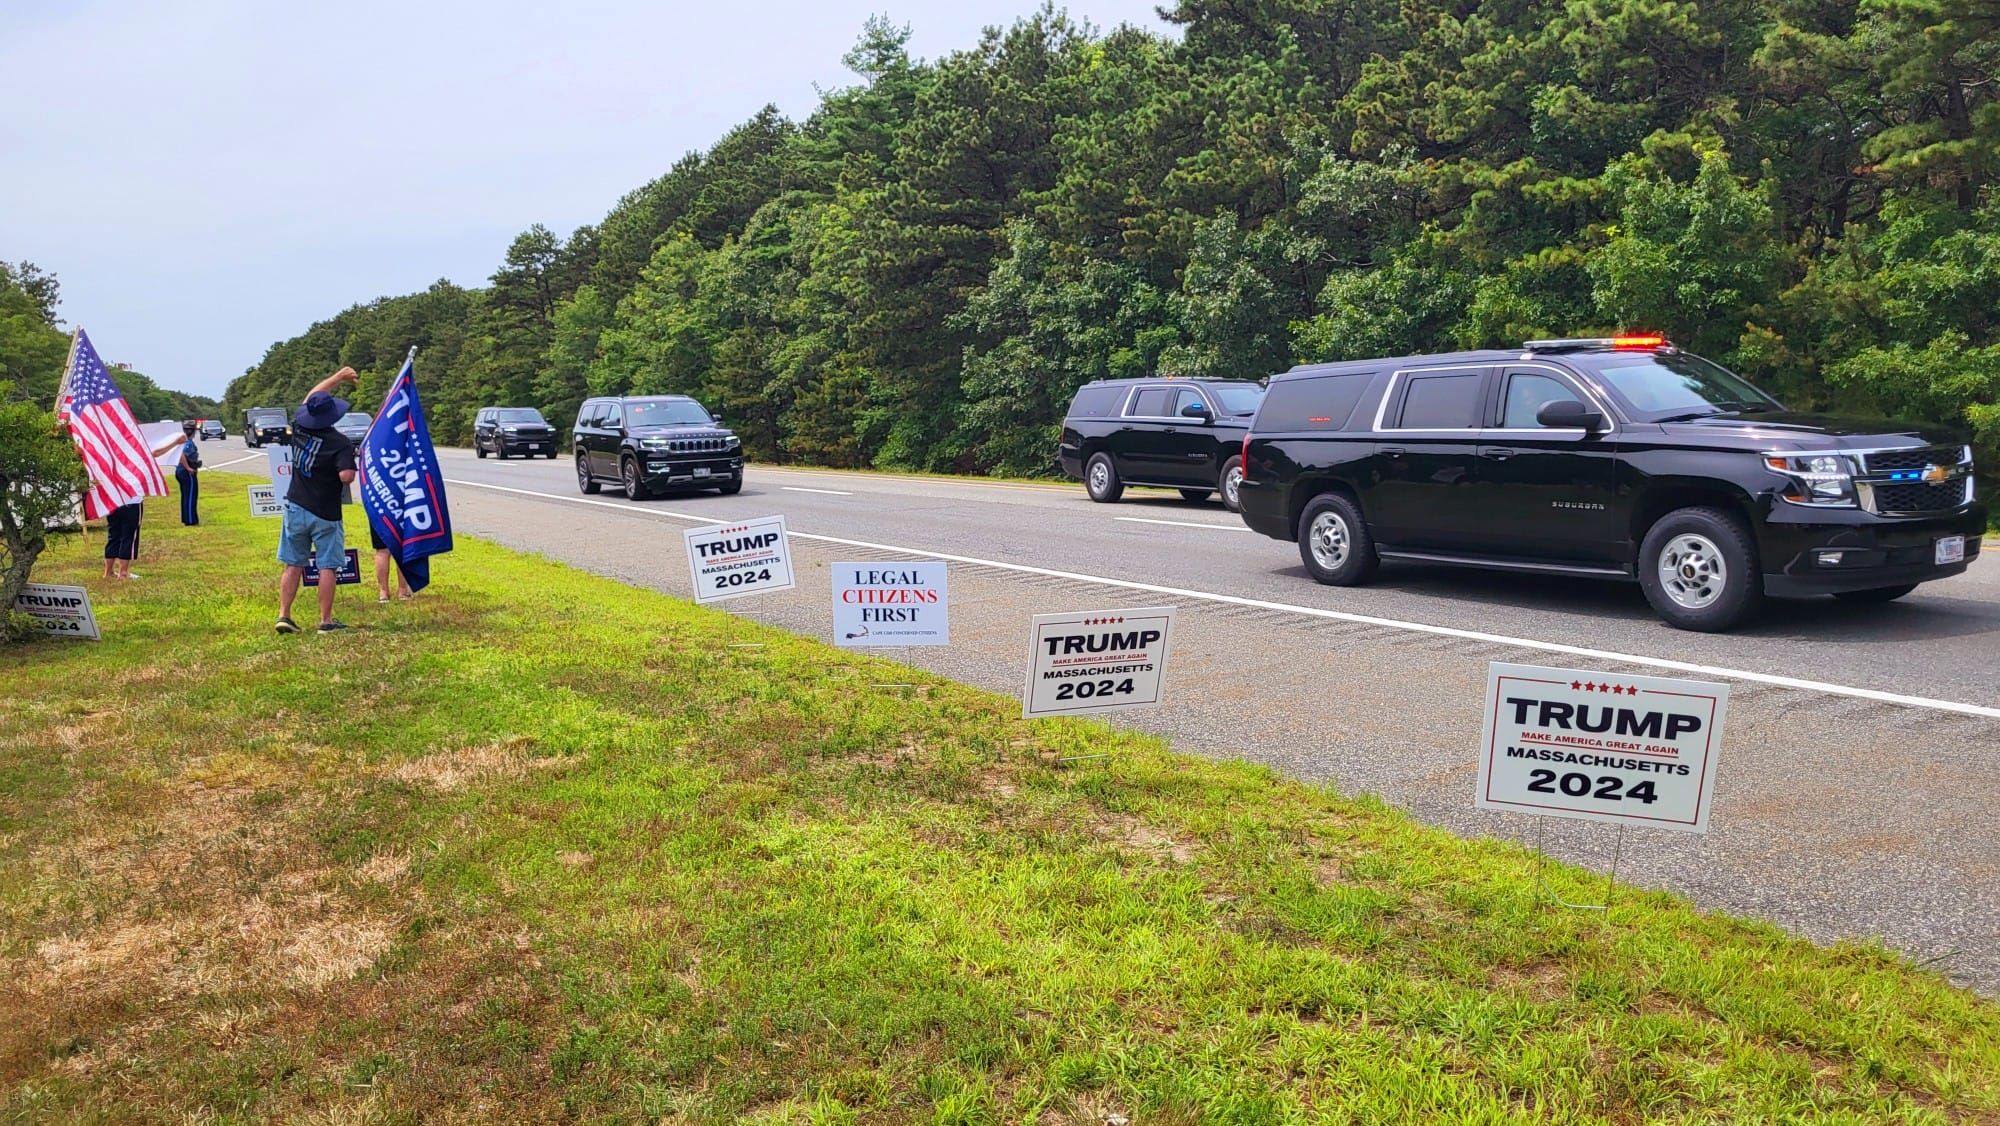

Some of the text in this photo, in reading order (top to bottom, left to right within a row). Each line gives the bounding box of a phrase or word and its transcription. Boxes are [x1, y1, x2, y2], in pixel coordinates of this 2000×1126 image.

[367, 466, 403, 520] AMERICA
[1552, 501, 1605, 510] SUBURBAN
[695, 533, 778, 557] TRUMP
[702, 557, 781, 575] MASSACHUSETTS
[715, 568, 772, 588] 2024
[854, 570, 924, 585] LEGAL
[18, 594, 82, 608] TRUMP
[842, 589, 938, 604] CITIZENS
[862, 608, 920, 622] FIRST
[1044, 630, 1160, 656] TRUMP
[1044, 664, 1153, 679] MASSACHUSETTS
[1056, 679, 1134, 700] 2024
[1506, 697, 1702, 740] TRUMP
[1522, 732, 1679, 754] MAKE AMERICA GREAT AGAIN
[1507, 747, 1690, 776] MASSACHUSETTS
[1527, 769, 1658, 804] 2024
